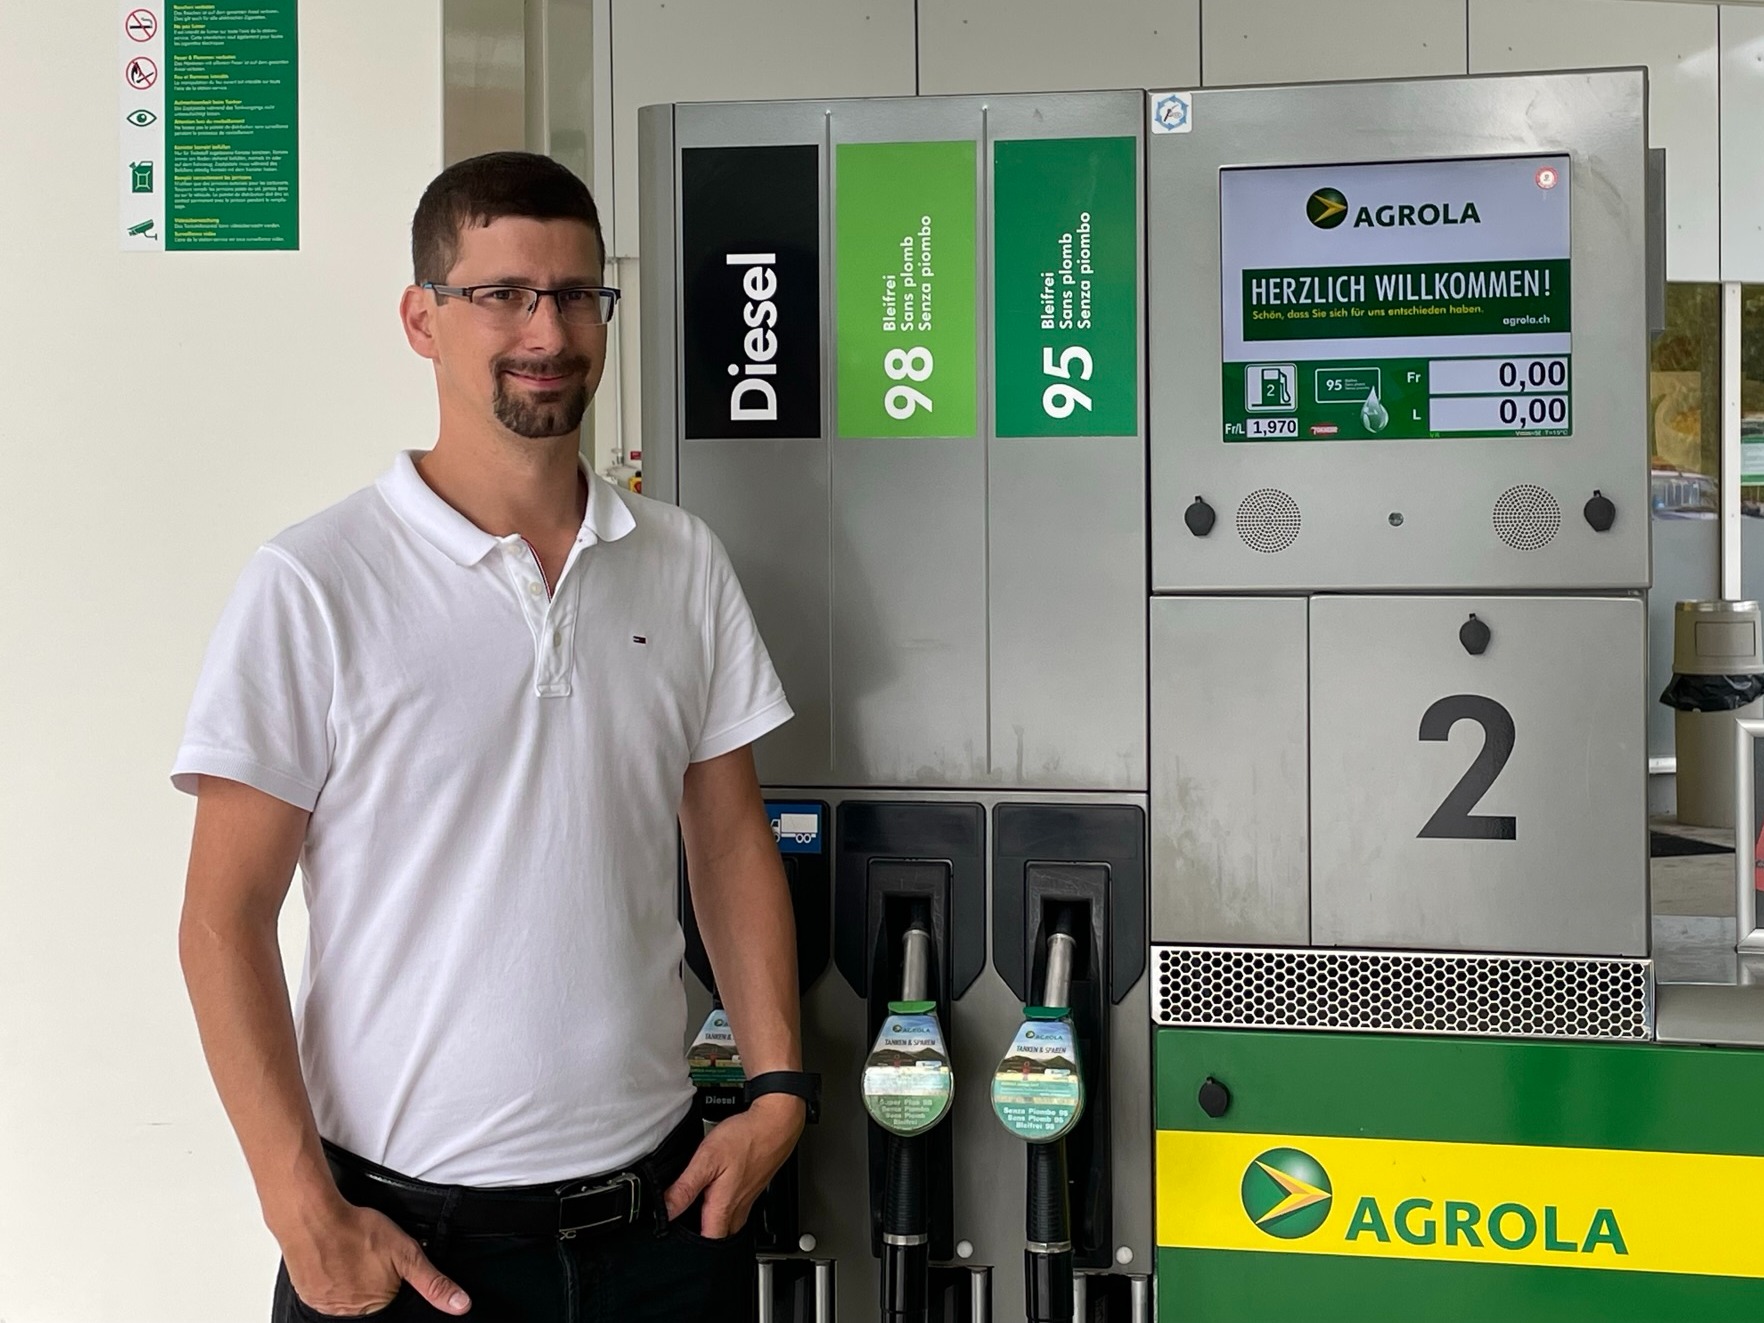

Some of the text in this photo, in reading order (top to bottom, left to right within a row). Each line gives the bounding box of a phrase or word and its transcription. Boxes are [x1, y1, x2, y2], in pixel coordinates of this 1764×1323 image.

[1353, 202, 1481, 228] AGROLA
[899, 236, 916, 331] Sans plomb
[917, 215, 935, 331] Senza piombo
[1058, 232, 1075, 329] Sans plomb
[1076, 212, 1094, 329] Senza piombo
[882, 275, 896, 331] Bleifrei
[1040, 271, 1055, 329] Bleifrei
[1251, 269, 1552, 305] HERZLICH WILLKOMMEN!
[1252, 304, 1484, 320] Schön, dass Sie sich für uns entschieden haben.
[1503, 315, 1551, 326] agrola.ch
[726, 252, 778, 421] Diesel
[884, 346, 934, 420] 98
[1042, 345, 1094, 419] 95
[1266, 384, 1275, 397] 2
[1326, 379, 1342, 391] 95
[1407, 372, 1421, 383] Fr
[1499, 360, 1566, 392] 0,00
[1225, 423, 1246, 435] Fr/L
[1253, 420, 1296, 436] 1,970
[1412, 409, 1422, 420] L
[1499, 398, 1567, 428] 0,00
[1416, 693, 1517, 841] 2
[705, 1096, 735, 1105] Diesel
[1003, 1106, 1026, 1114] Senza
[1344, 1196, 1630, 1256] AGROLA
